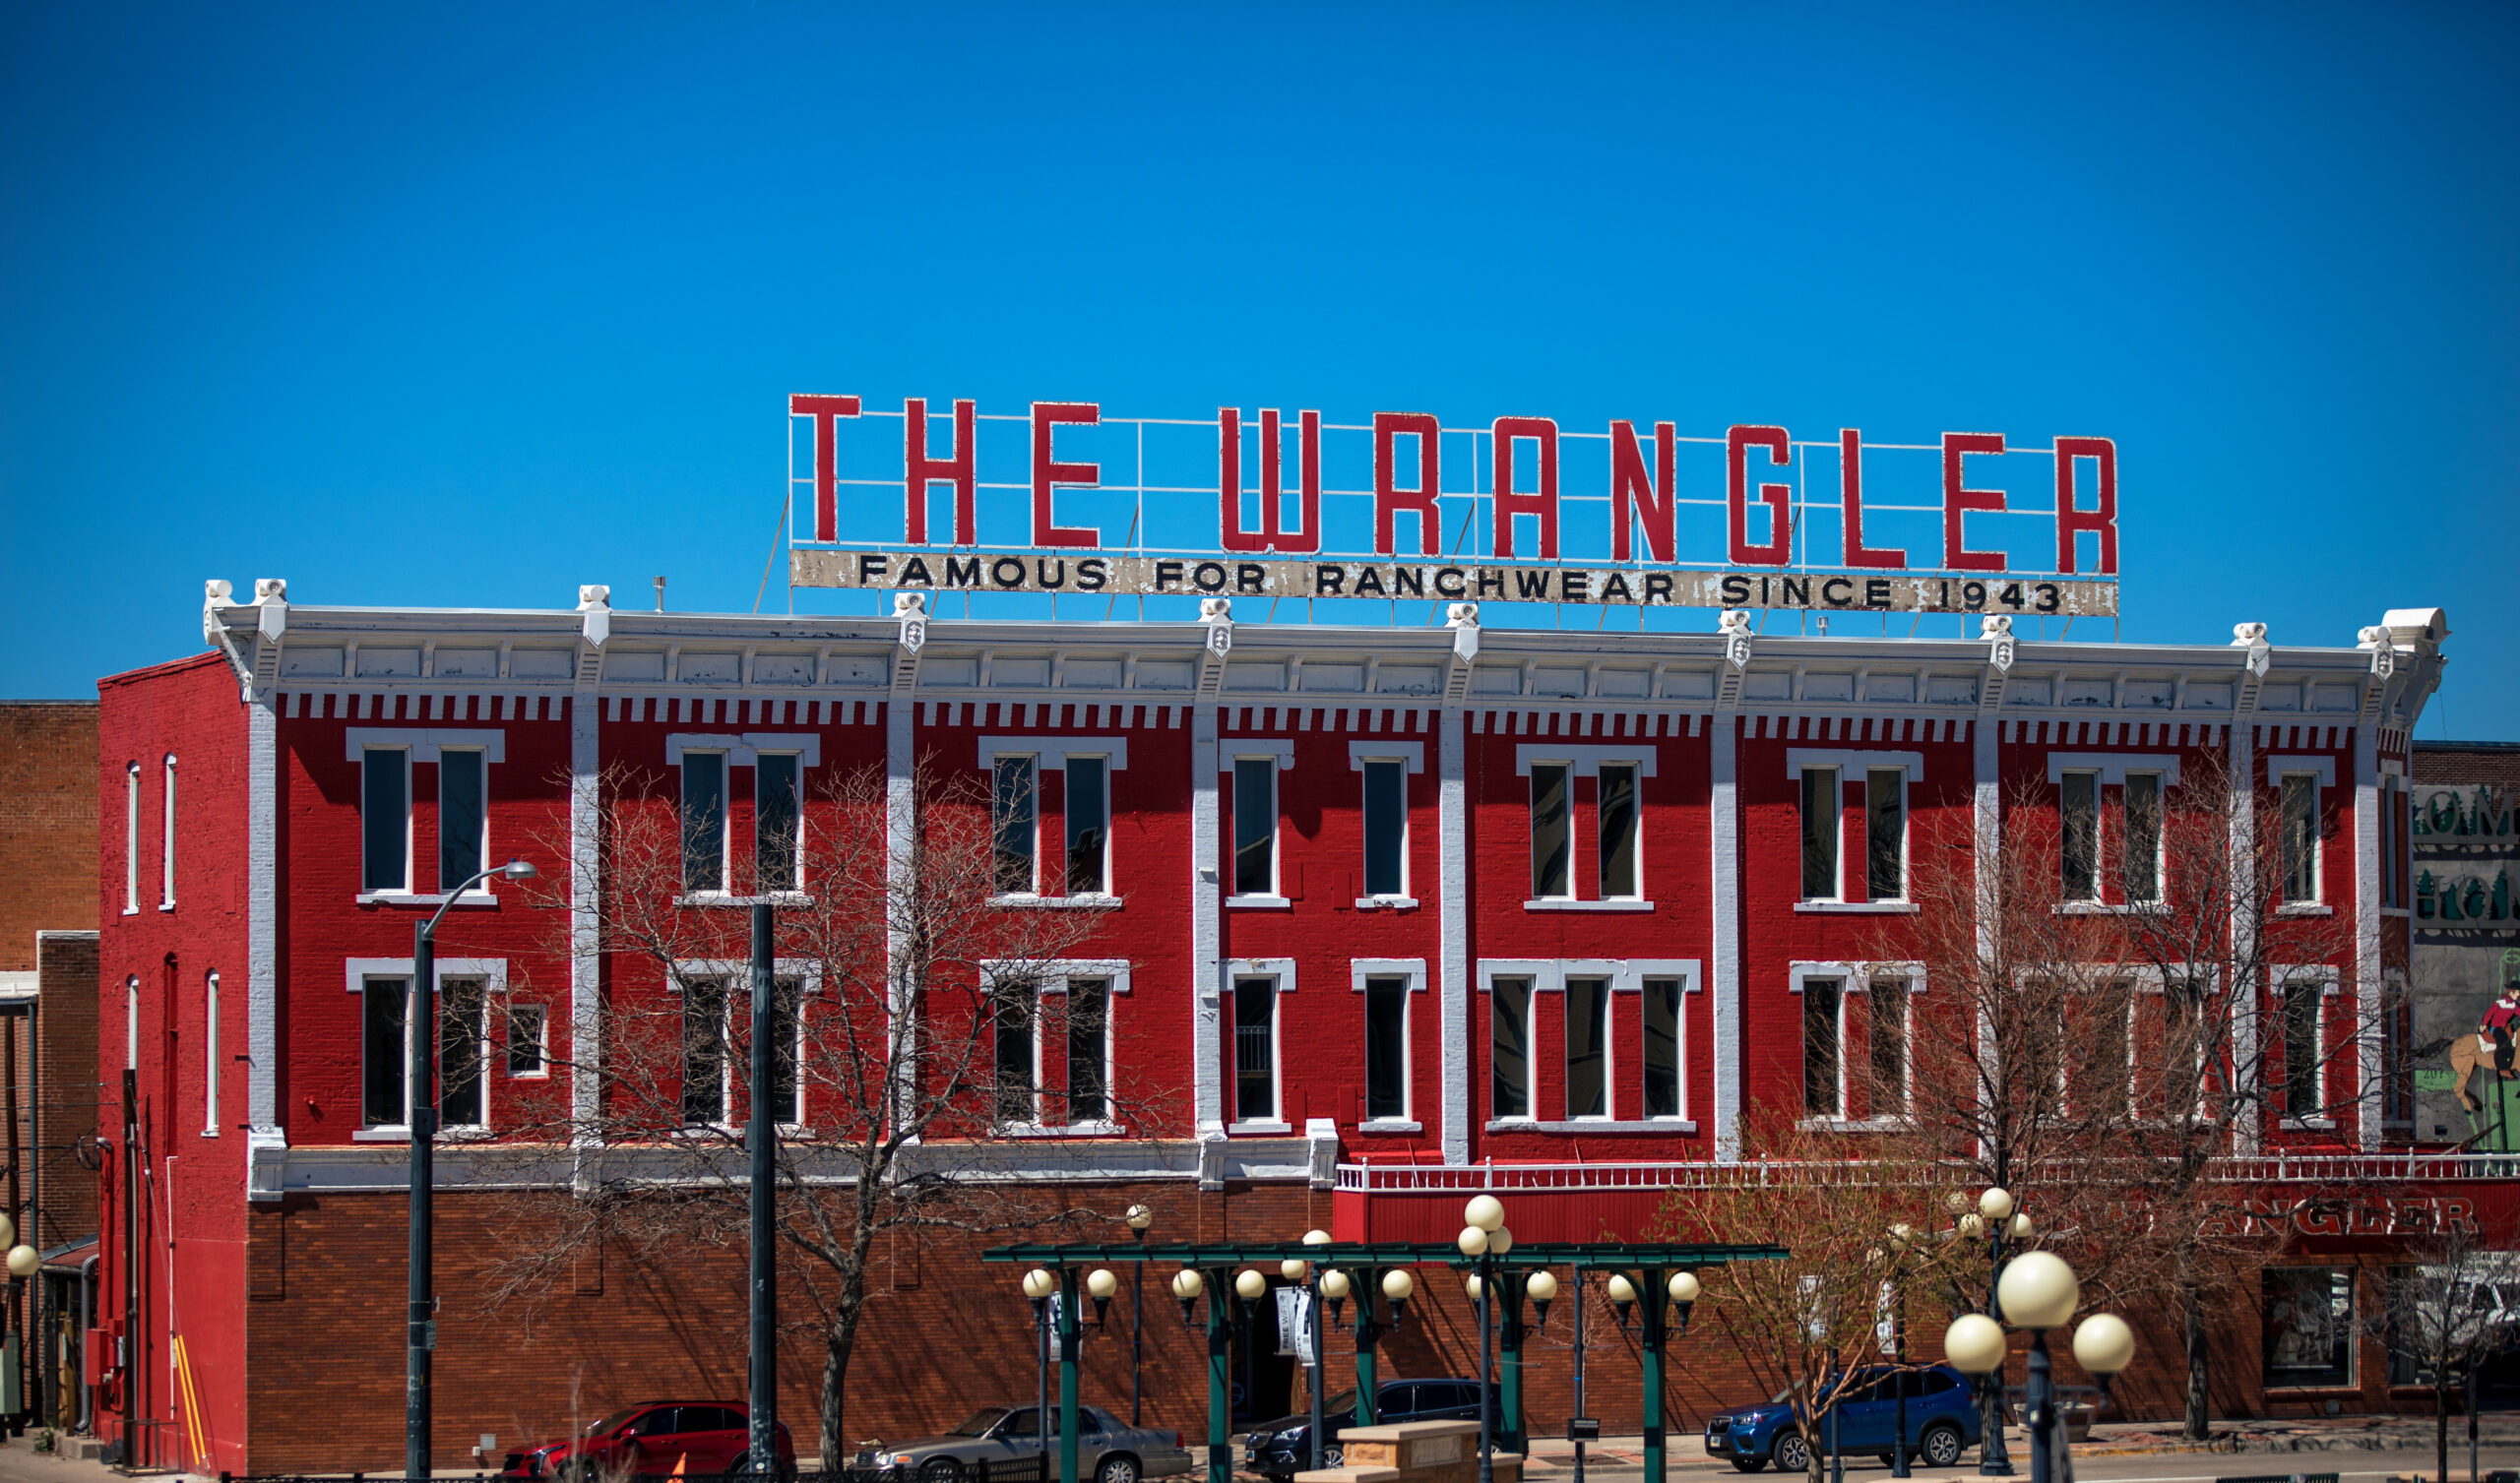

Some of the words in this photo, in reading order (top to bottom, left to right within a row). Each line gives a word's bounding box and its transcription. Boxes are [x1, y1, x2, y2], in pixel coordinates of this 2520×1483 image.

[788, 393, 1101, 549] THE
[1219, 406, 2118, 574] WRANGLER
[858, 556, 1107, 592] FAMOUS
[1155, 562, 1266, 594] FOR
[1315, 566, 1674, 602] RANCHWEAR
[1721, 576, 1892, 606] SINCE
[1939, 582, 2059, 610] 1943
